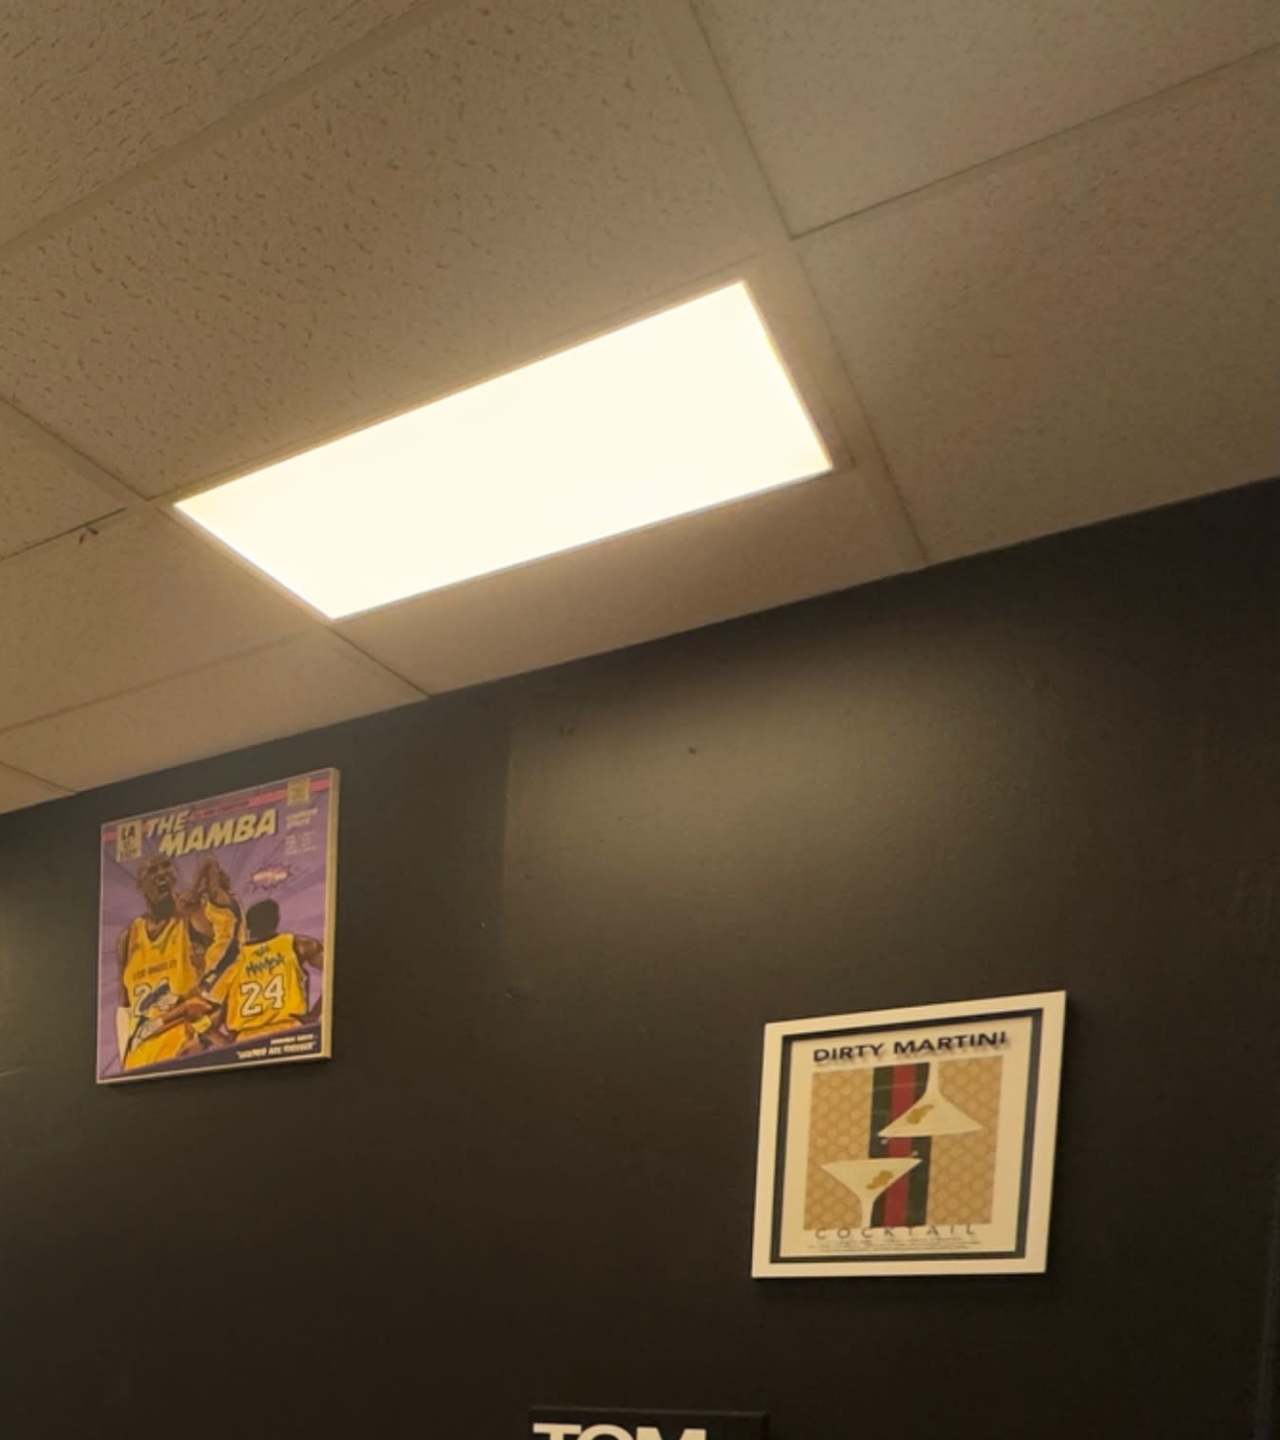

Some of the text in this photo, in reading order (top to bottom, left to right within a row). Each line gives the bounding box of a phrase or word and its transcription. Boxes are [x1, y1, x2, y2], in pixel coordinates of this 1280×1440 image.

[142, 810, 191, 838] THE
[159, 808, 276, 858] MAMBA
[241, 974, 284, 1017] 24
[813, 1031, 1007, 1063] DIRTY MARTINI
[815, 1224, 975, 1239] COCKTAIL
